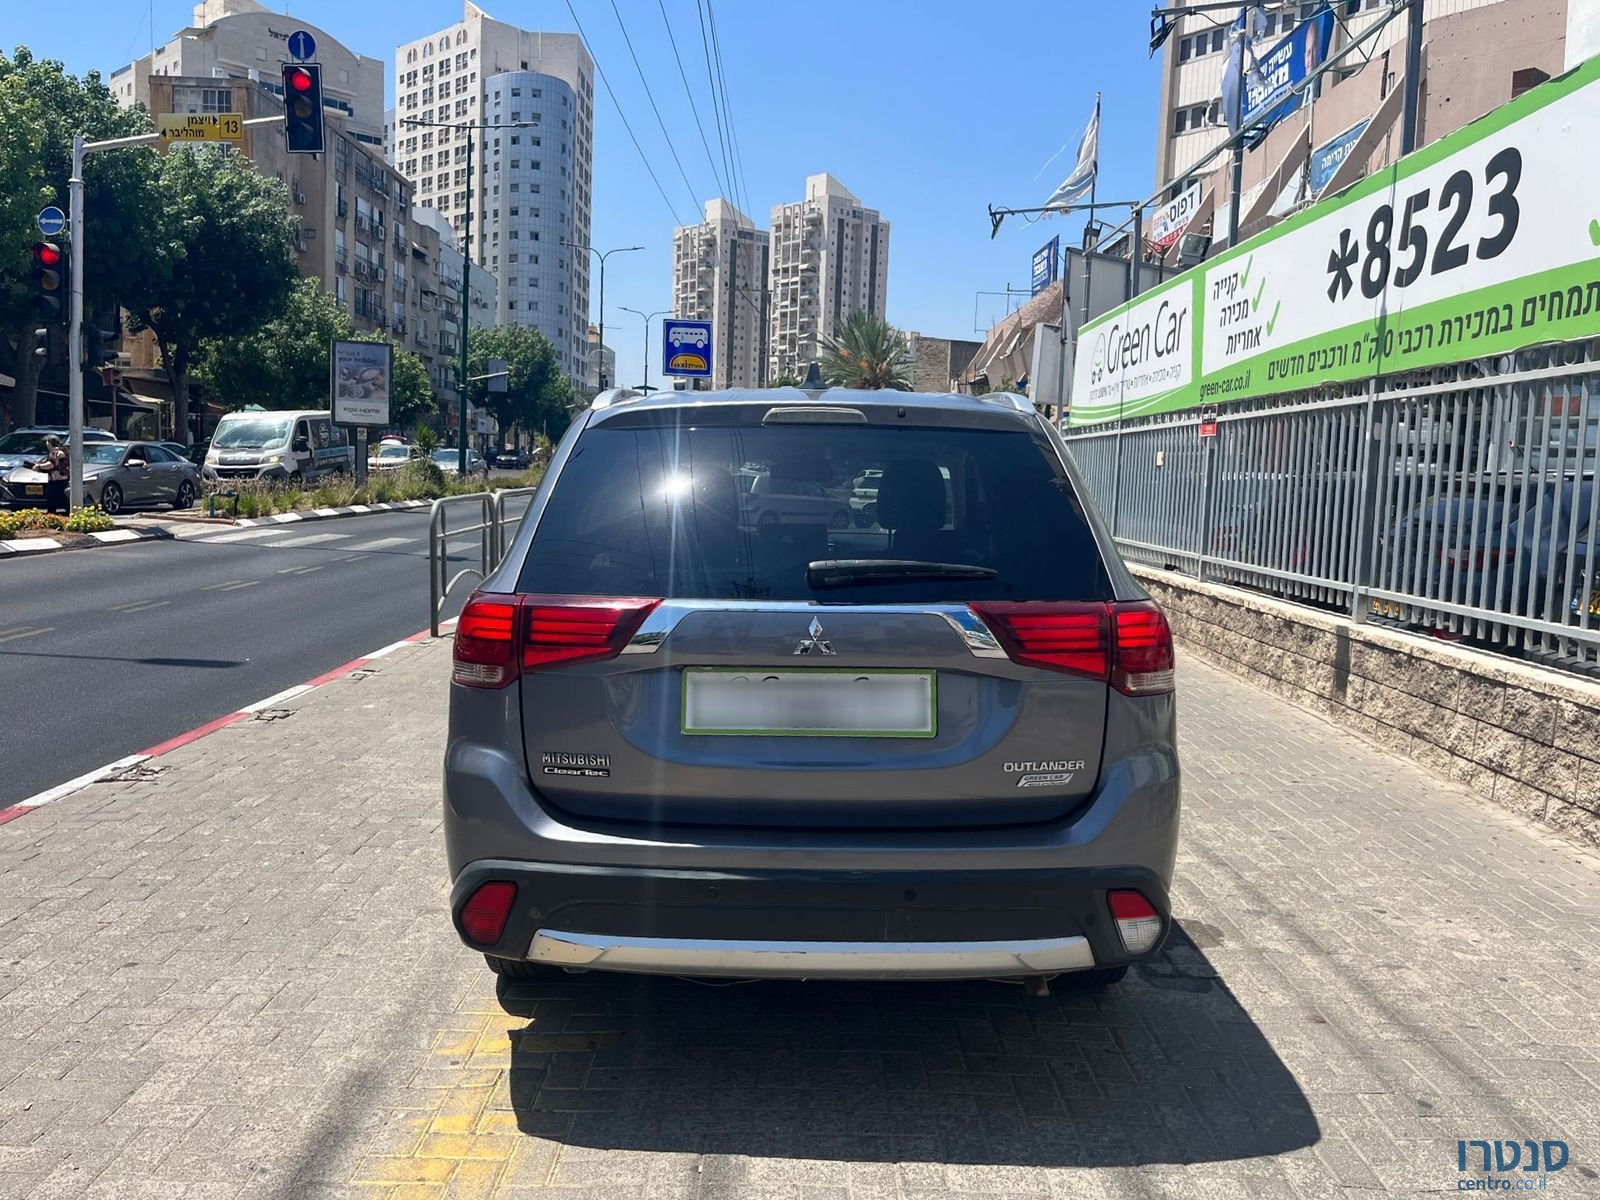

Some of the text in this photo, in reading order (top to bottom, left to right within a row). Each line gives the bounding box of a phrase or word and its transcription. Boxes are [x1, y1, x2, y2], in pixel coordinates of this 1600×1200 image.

[169, 127, 205, 138] מוהליבר
[187, 115, 211, 127] ויצמן
[224, 120, 239, 134] 13
[1321, 147, 1343, 170] קדימה
[1169, 191, 1195, 223] דפוס
[1213, 272, 1239, 300] קנייה
[1220, 298, 1249, 327] מכירה
[1437, 303, 1513, 347] במכירת
[1107, 300, 1187, 375] Green Car
[1226, 325, 1262, 356] אחריות
[1398, 323, 1434, 355] רכבי
[1268, 354, 1304, 381] חדשים
[1307, 343, 1348, 373] ורכבים
[1199, 369, 1251, 402] green-car.co.il
[542, 752, 611, 767] MITSUBISHI
[544, 766, 609, 777] ClearTec
[1003, 760, 1085, 772] OUTLANDER
